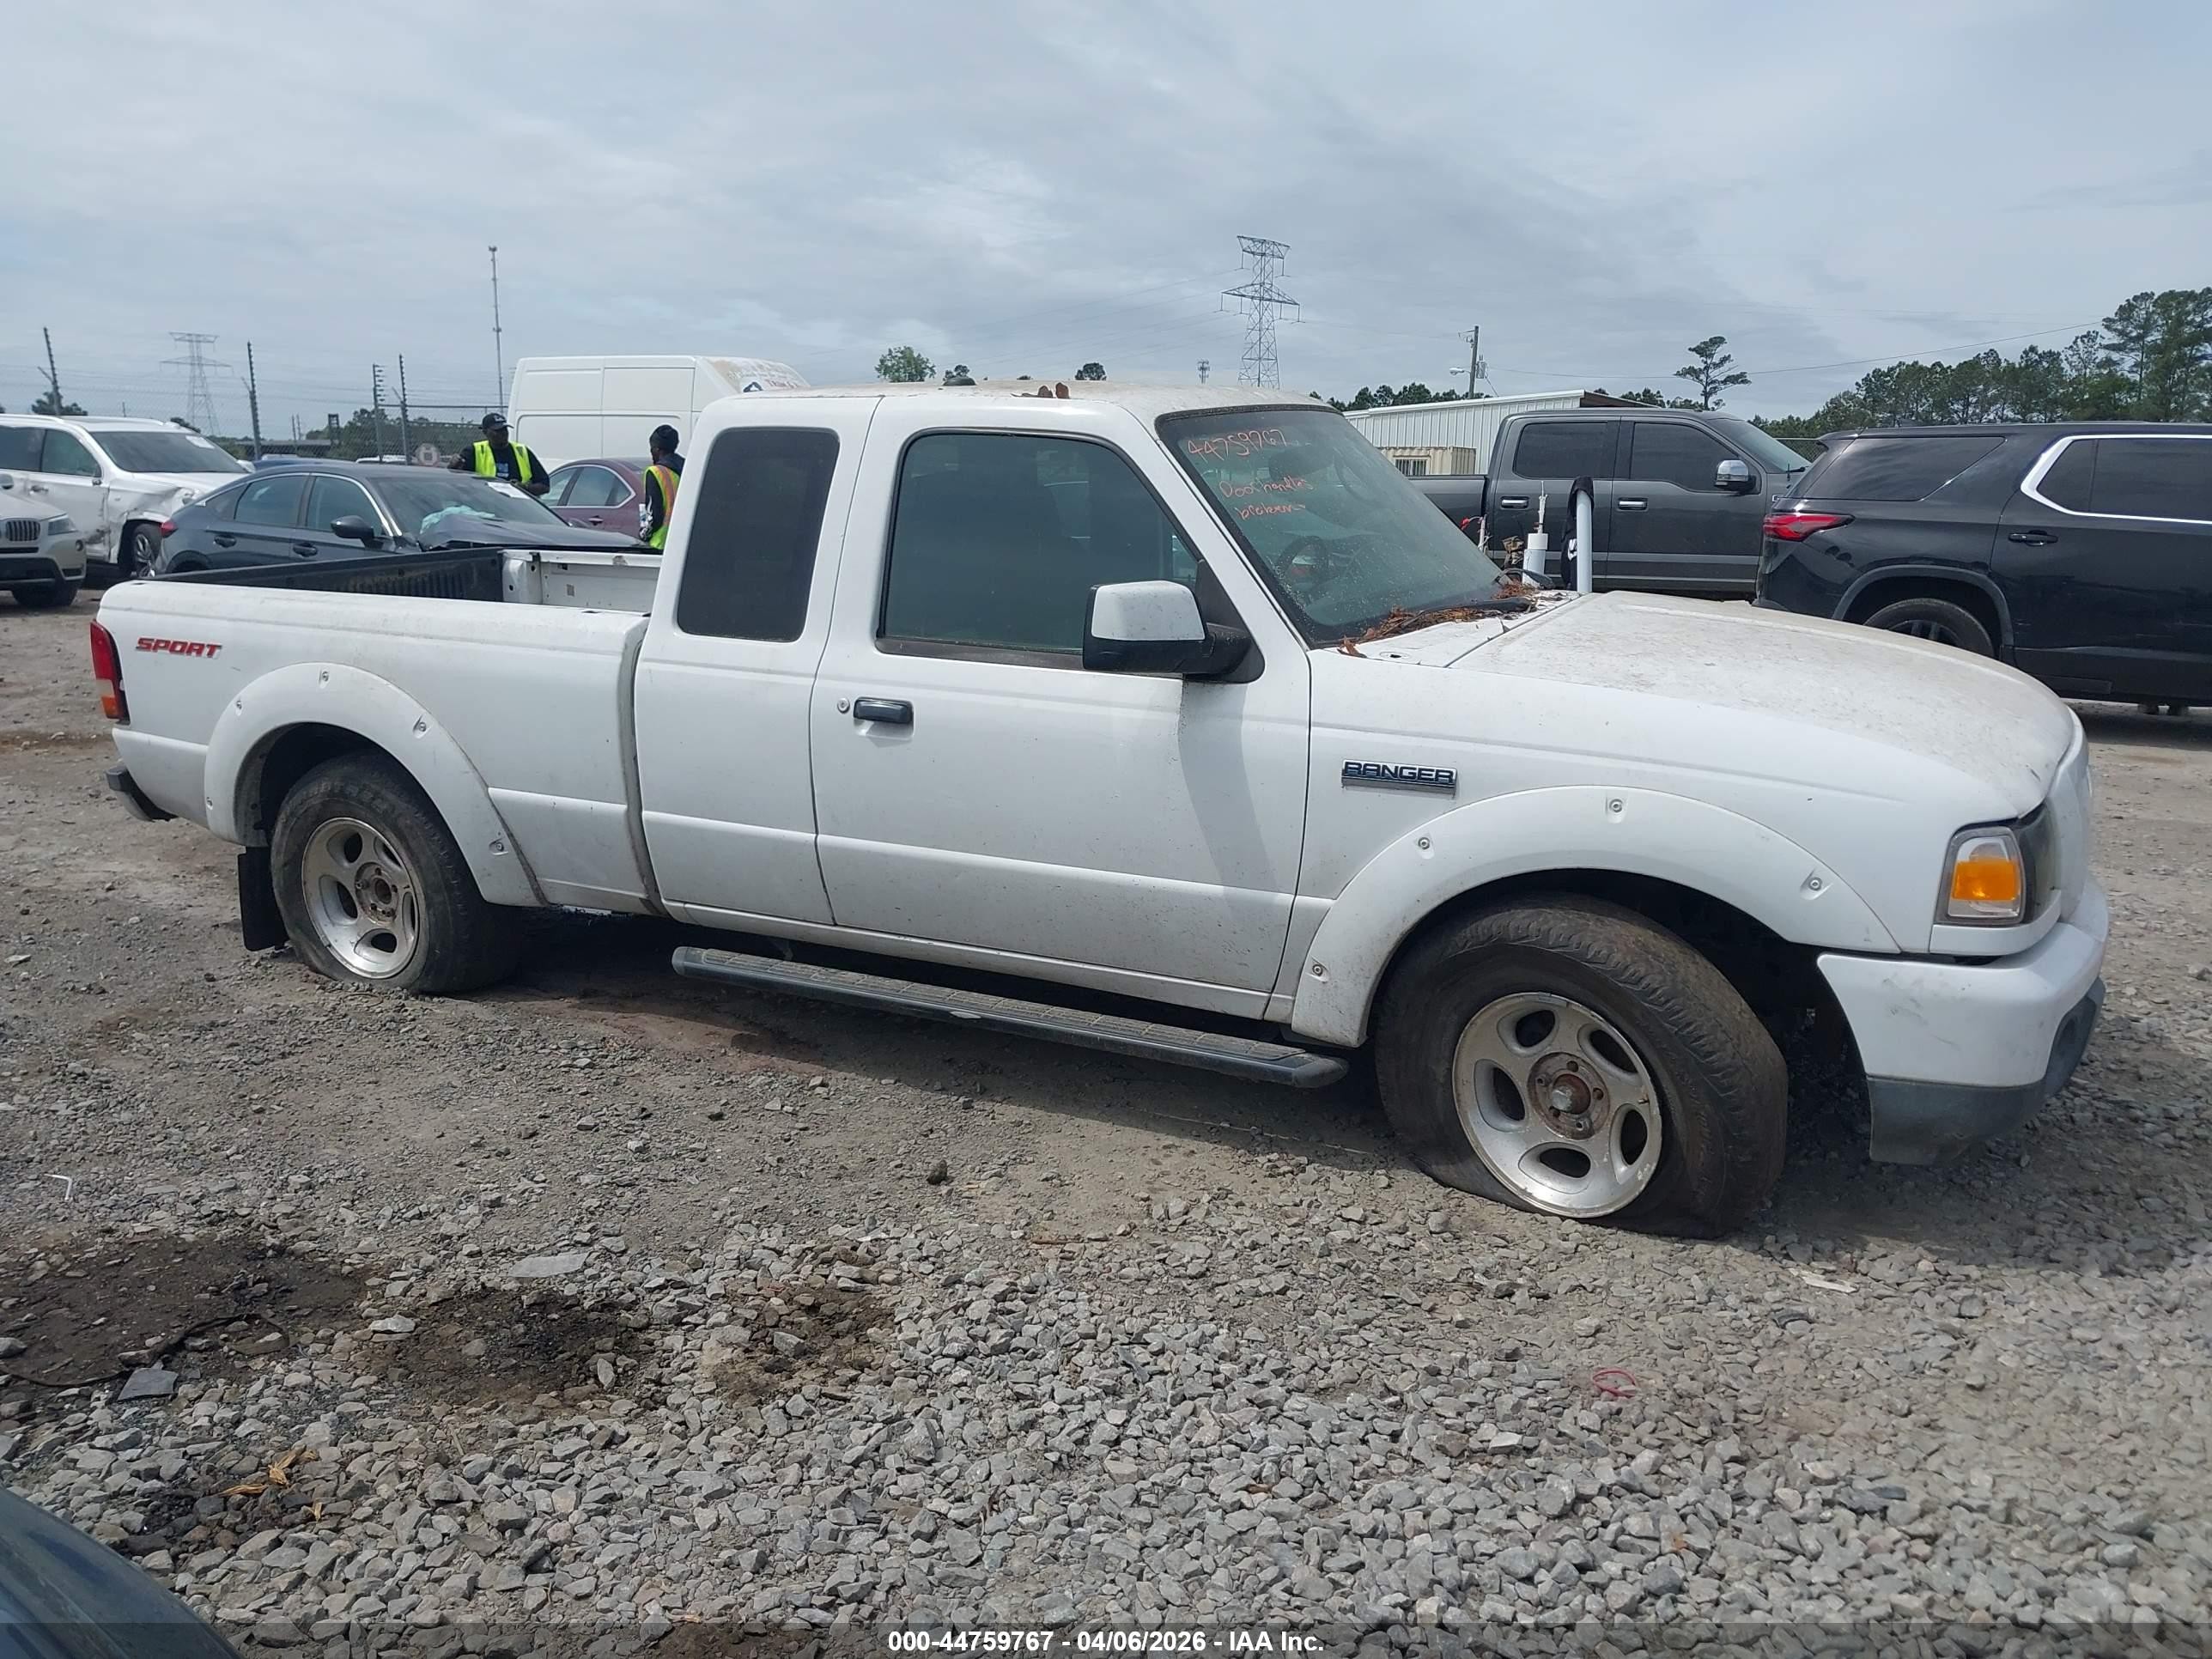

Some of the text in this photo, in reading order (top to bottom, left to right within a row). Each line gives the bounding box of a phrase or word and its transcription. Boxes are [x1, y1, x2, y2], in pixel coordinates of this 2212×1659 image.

[1188, 429, 1288, 464] 44759767
[136, 636, 222, 659] SPORT
[1342, 760, 1456, 786] RANGER
